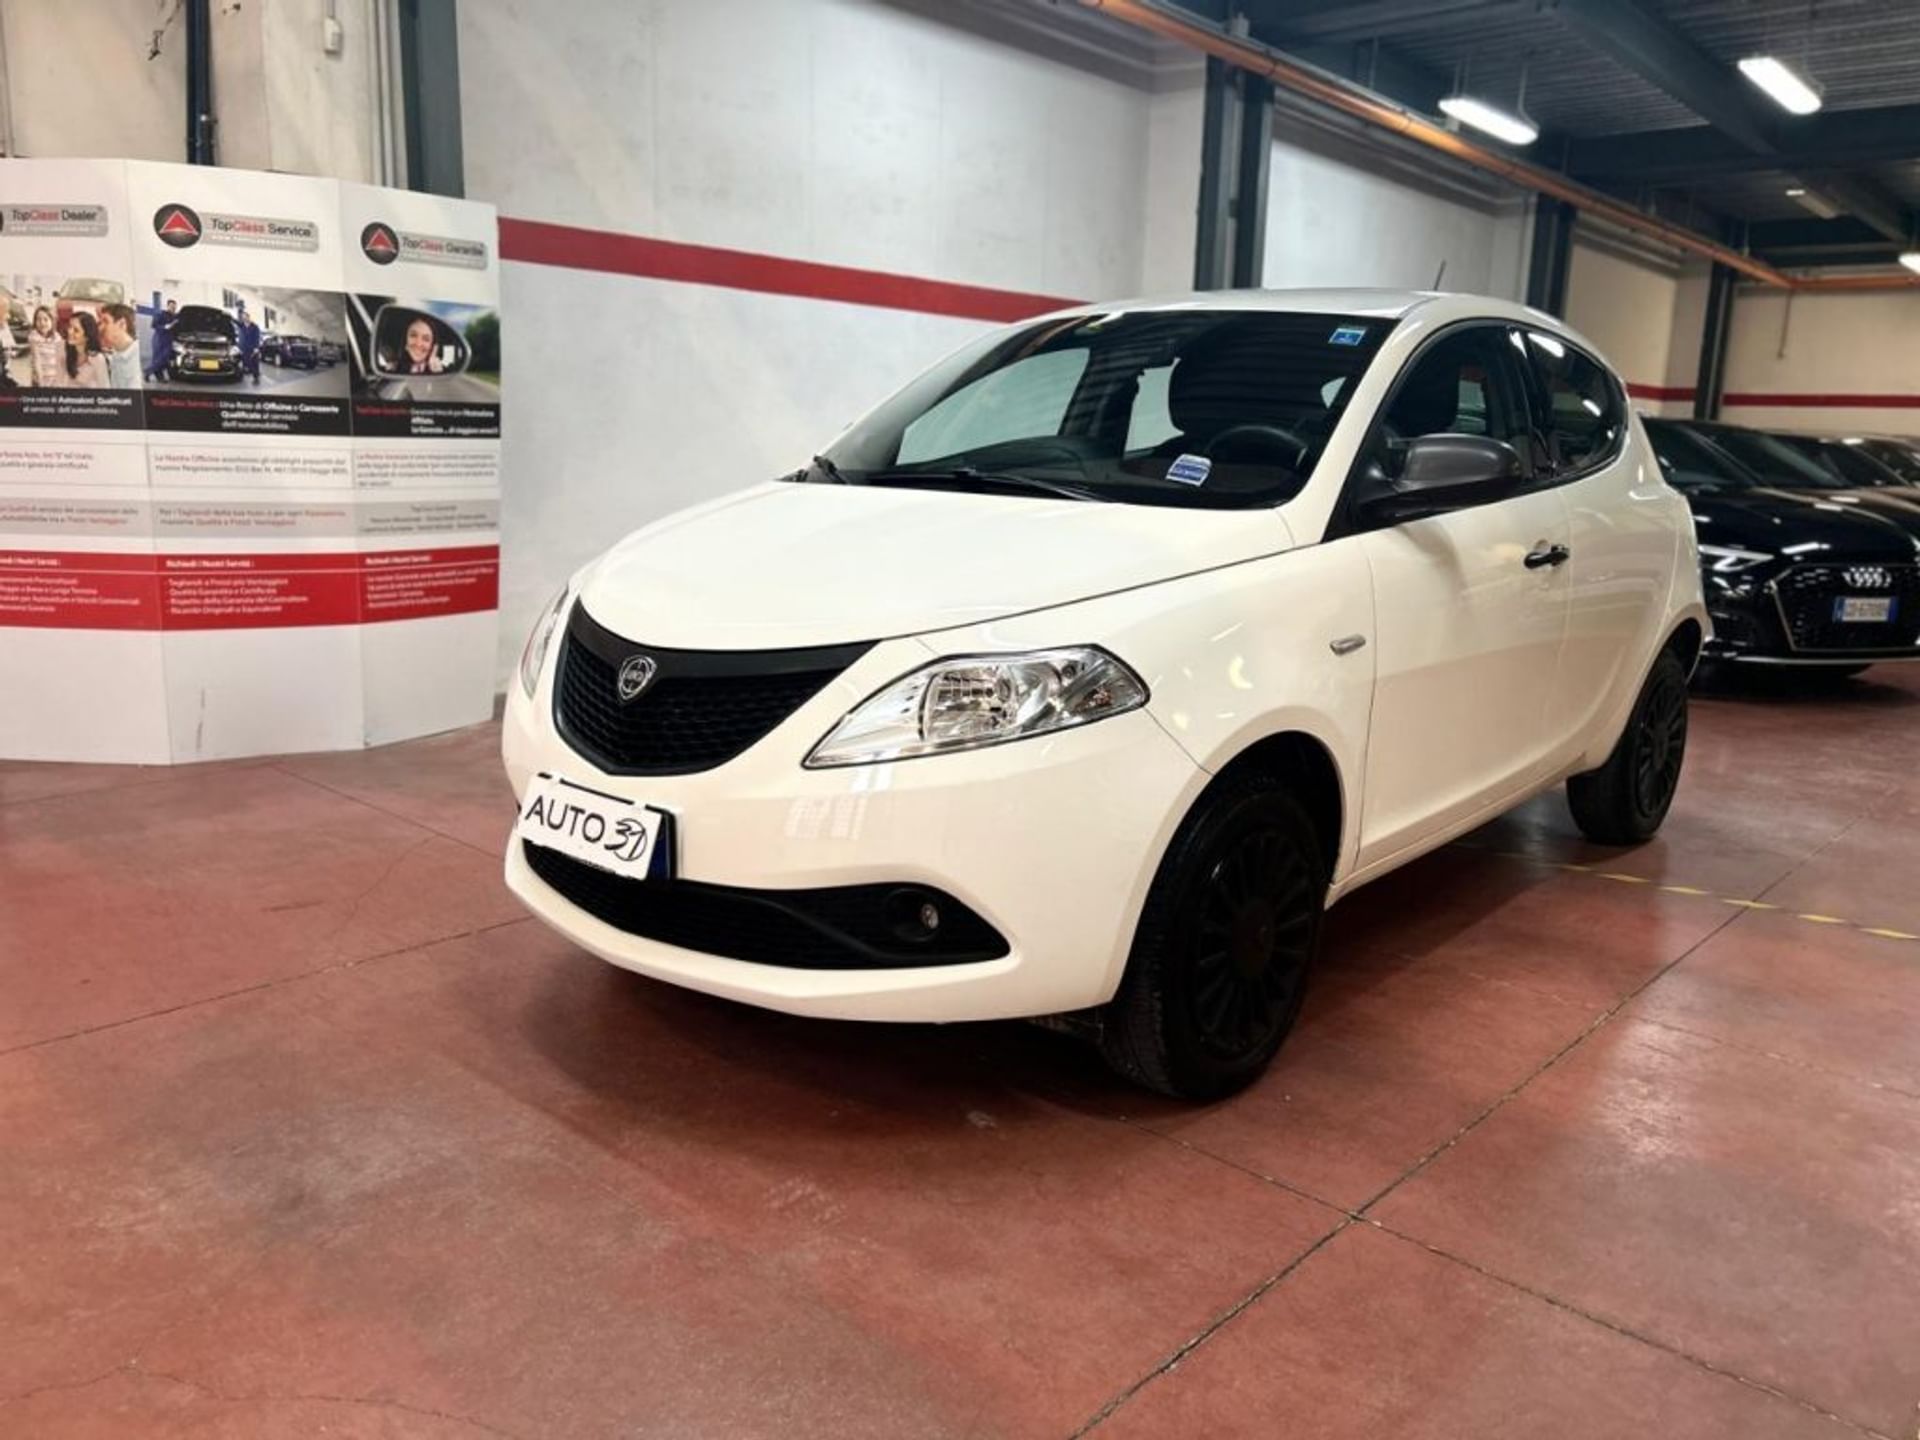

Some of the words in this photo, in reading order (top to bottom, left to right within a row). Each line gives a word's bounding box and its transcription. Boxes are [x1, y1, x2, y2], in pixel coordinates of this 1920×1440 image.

[61, 209, 97, 221] Dealer
[212, 217, 265, 232] TopClass
[267, 223, 312, 237] Service
[524, 795, 606, 843] AUTO
